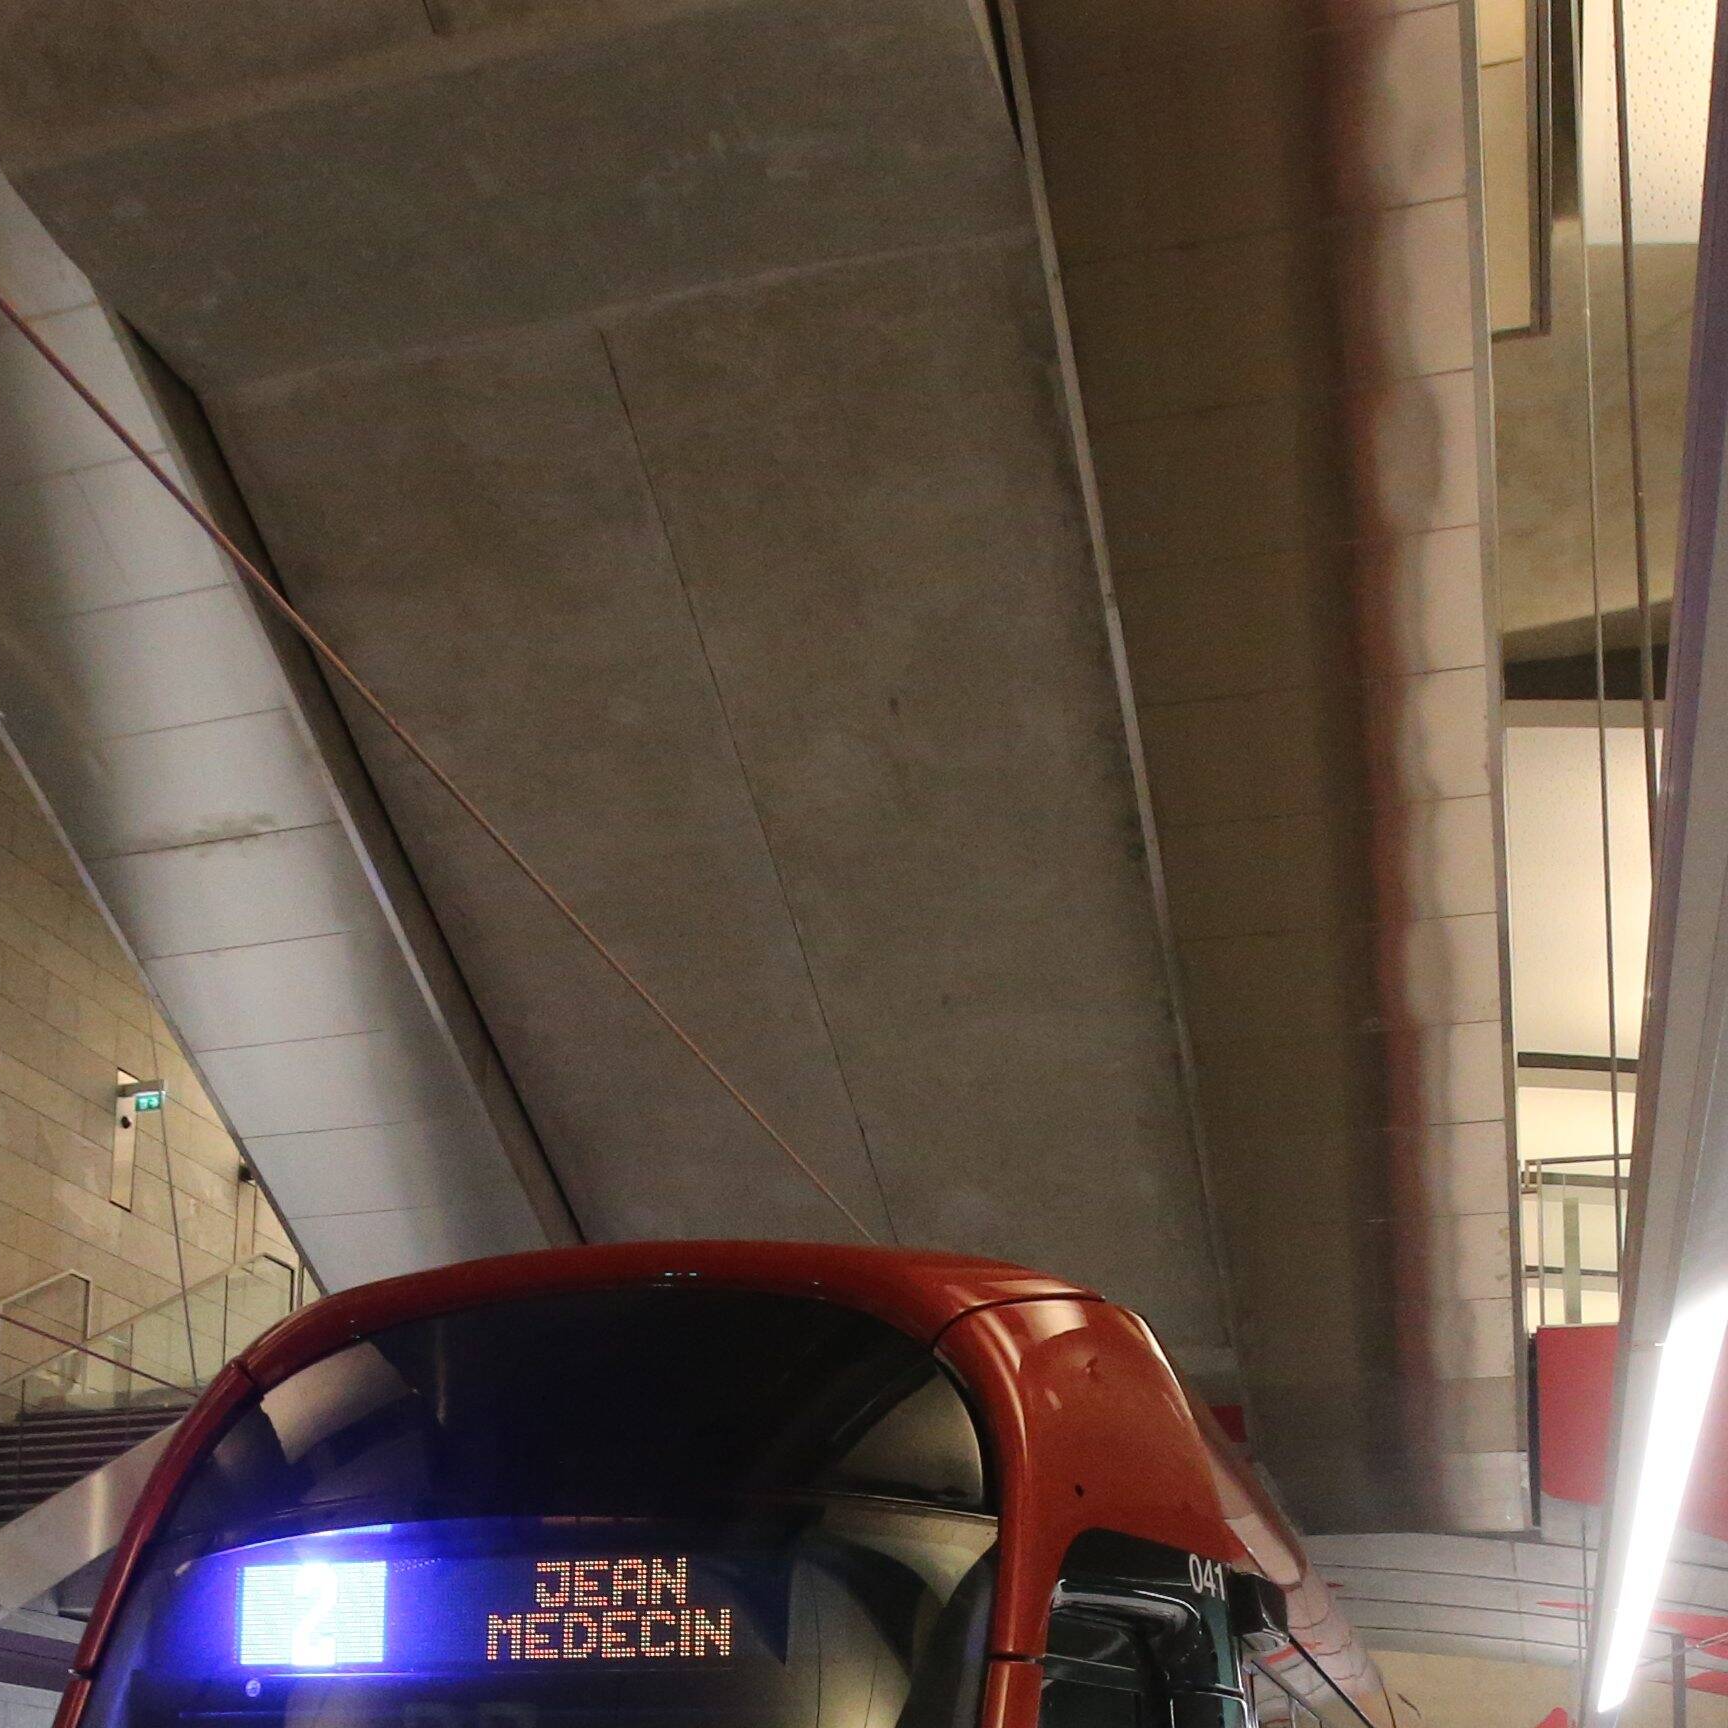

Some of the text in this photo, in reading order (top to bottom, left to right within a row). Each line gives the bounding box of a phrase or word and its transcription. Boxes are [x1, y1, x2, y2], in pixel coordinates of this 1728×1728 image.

[535, 1557, 687, 1608] JEAN
[1189, 1553, 1226, 1601] 041
[291, 1562, 338, 1666] 2
[486, 1608, 731, 1660] MEDECIN
